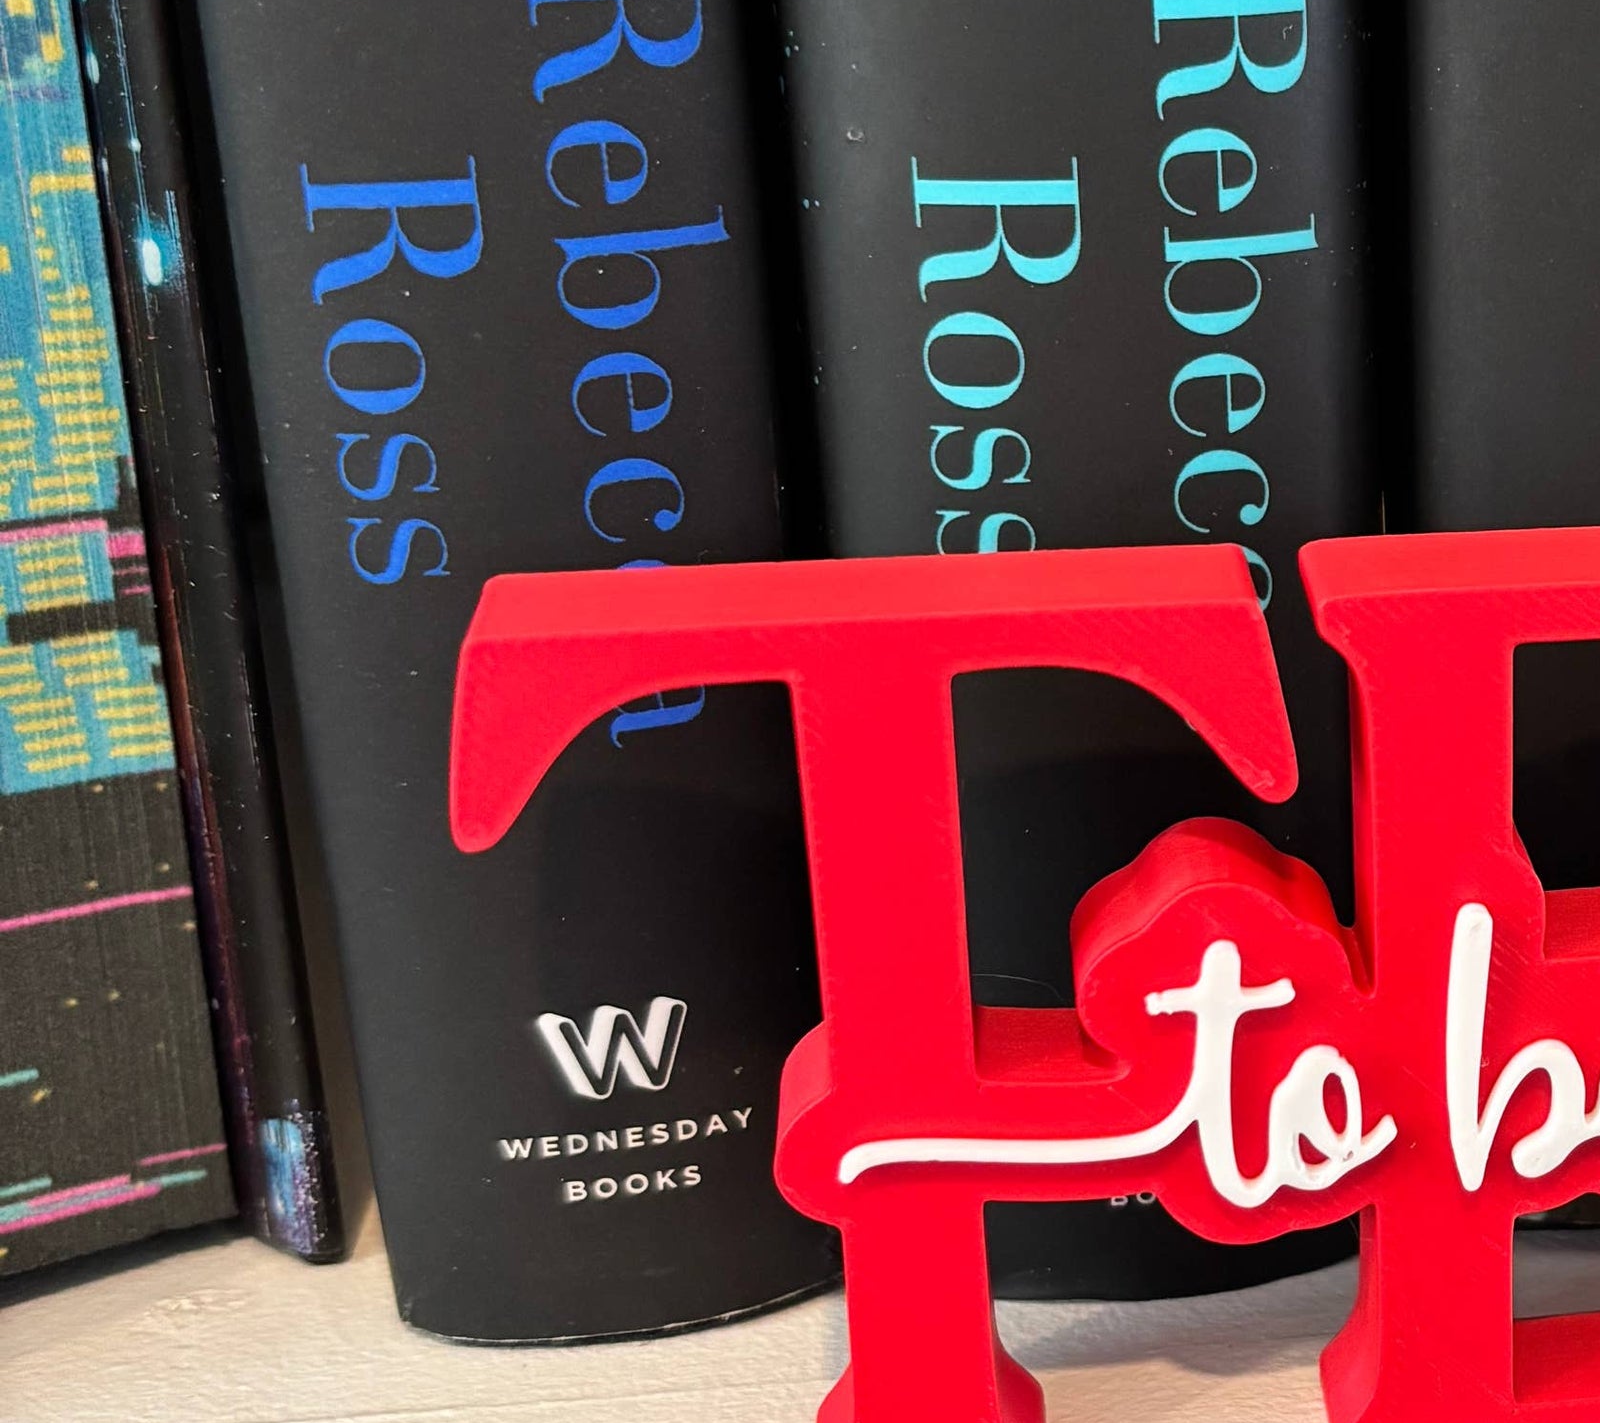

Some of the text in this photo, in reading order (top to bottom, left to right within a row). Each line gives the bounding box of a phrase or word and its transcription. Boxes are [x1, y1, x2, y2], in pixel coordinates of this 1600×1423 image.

[300, 154, 484, 585] Ross
[910, 155, 1083, 557] Ross
[499, 1106, 753, 1162] WEDNESDAY
[563, 1164, 703, 1204] BOOKS
